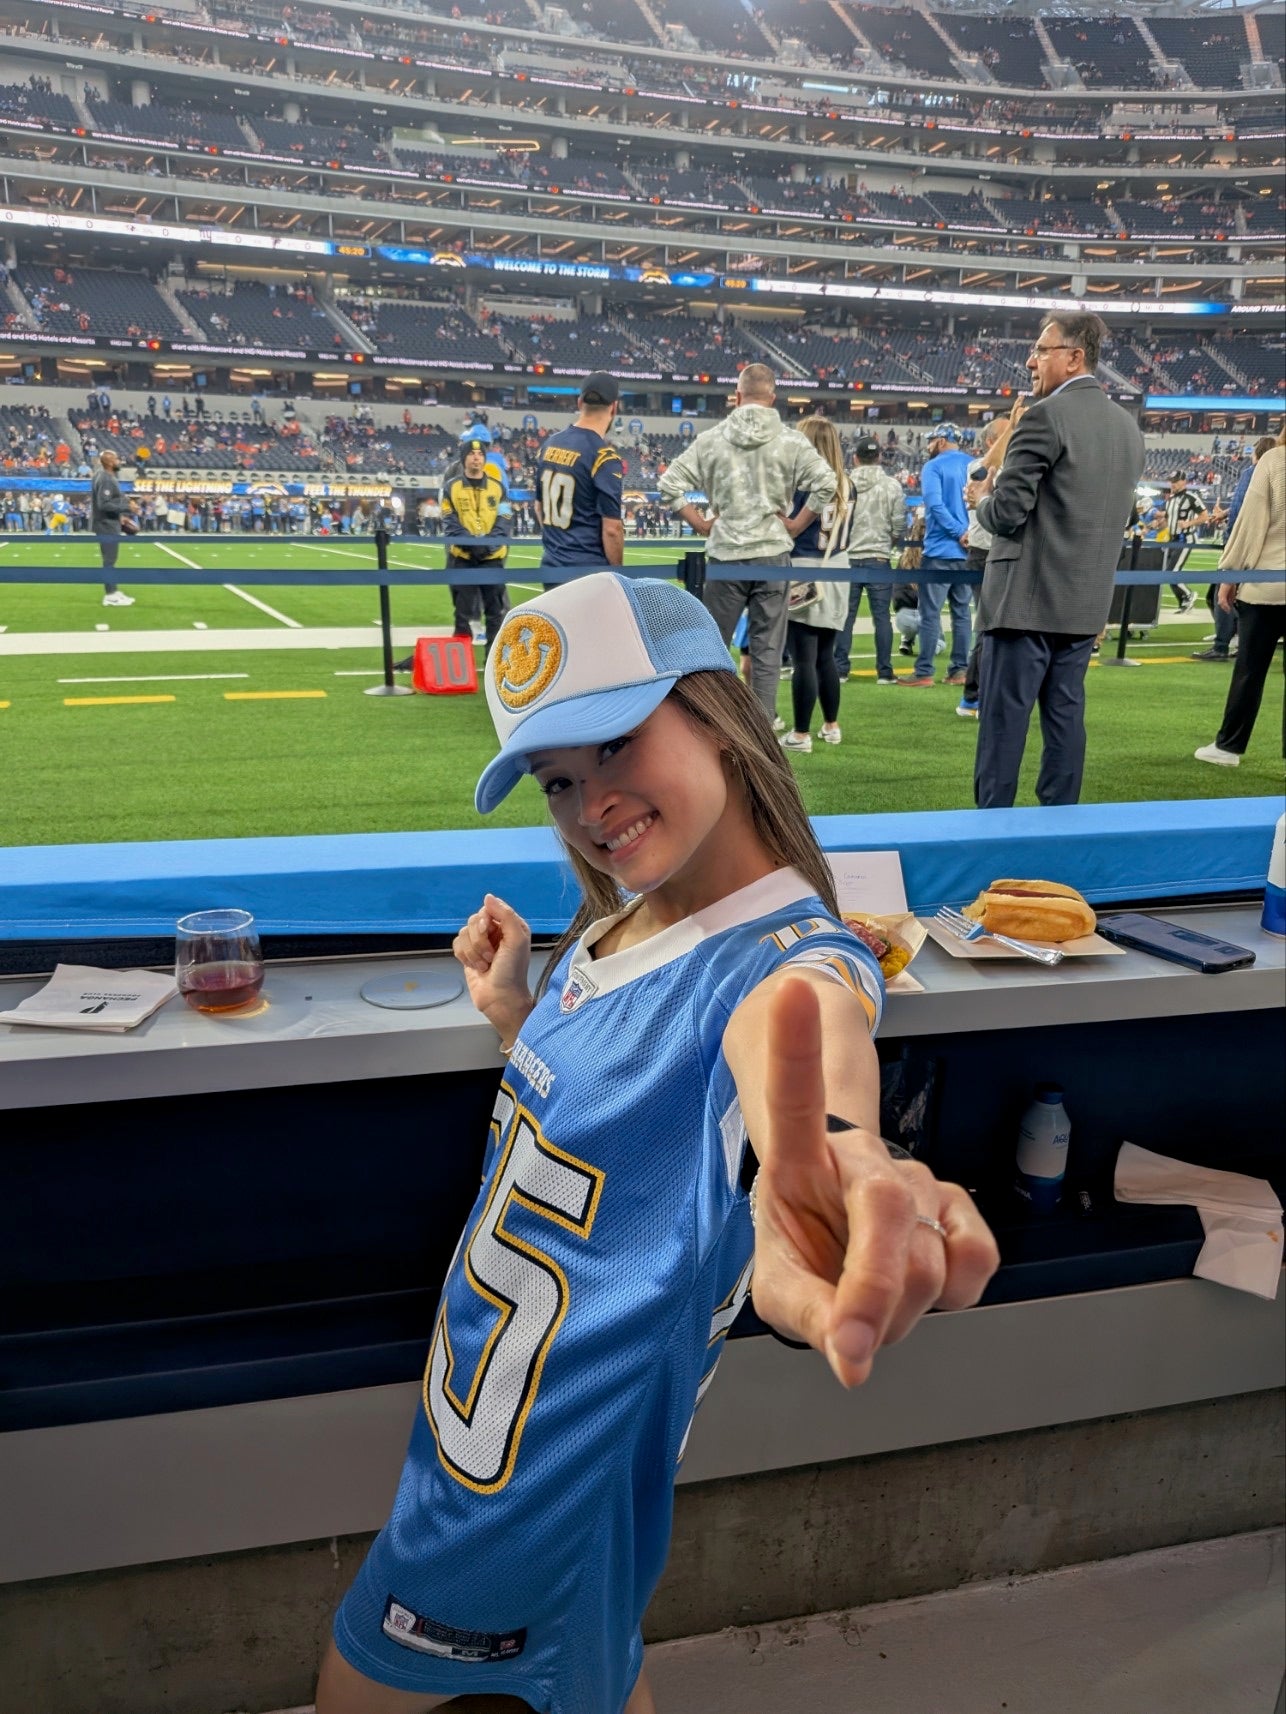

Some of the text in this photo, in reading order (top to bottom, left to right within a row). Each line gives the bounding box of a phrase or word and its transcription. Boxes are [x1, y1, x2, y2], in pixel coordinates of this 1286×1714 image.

[494, 258, 610, 279] WELCOME TO THE STORM
[1231, 305, 1261, 313] AROUND
[543, 446, 581, 467] HERBERT
[134, 479, 233, 494] SEE THE LIGHTNING
[304, 483, 392, 497] FEEL THE THUNDER
[58, 500, 64, 511] 7
[541, 469, 576, 529] 10
[428, 642, 469, 686] 10
